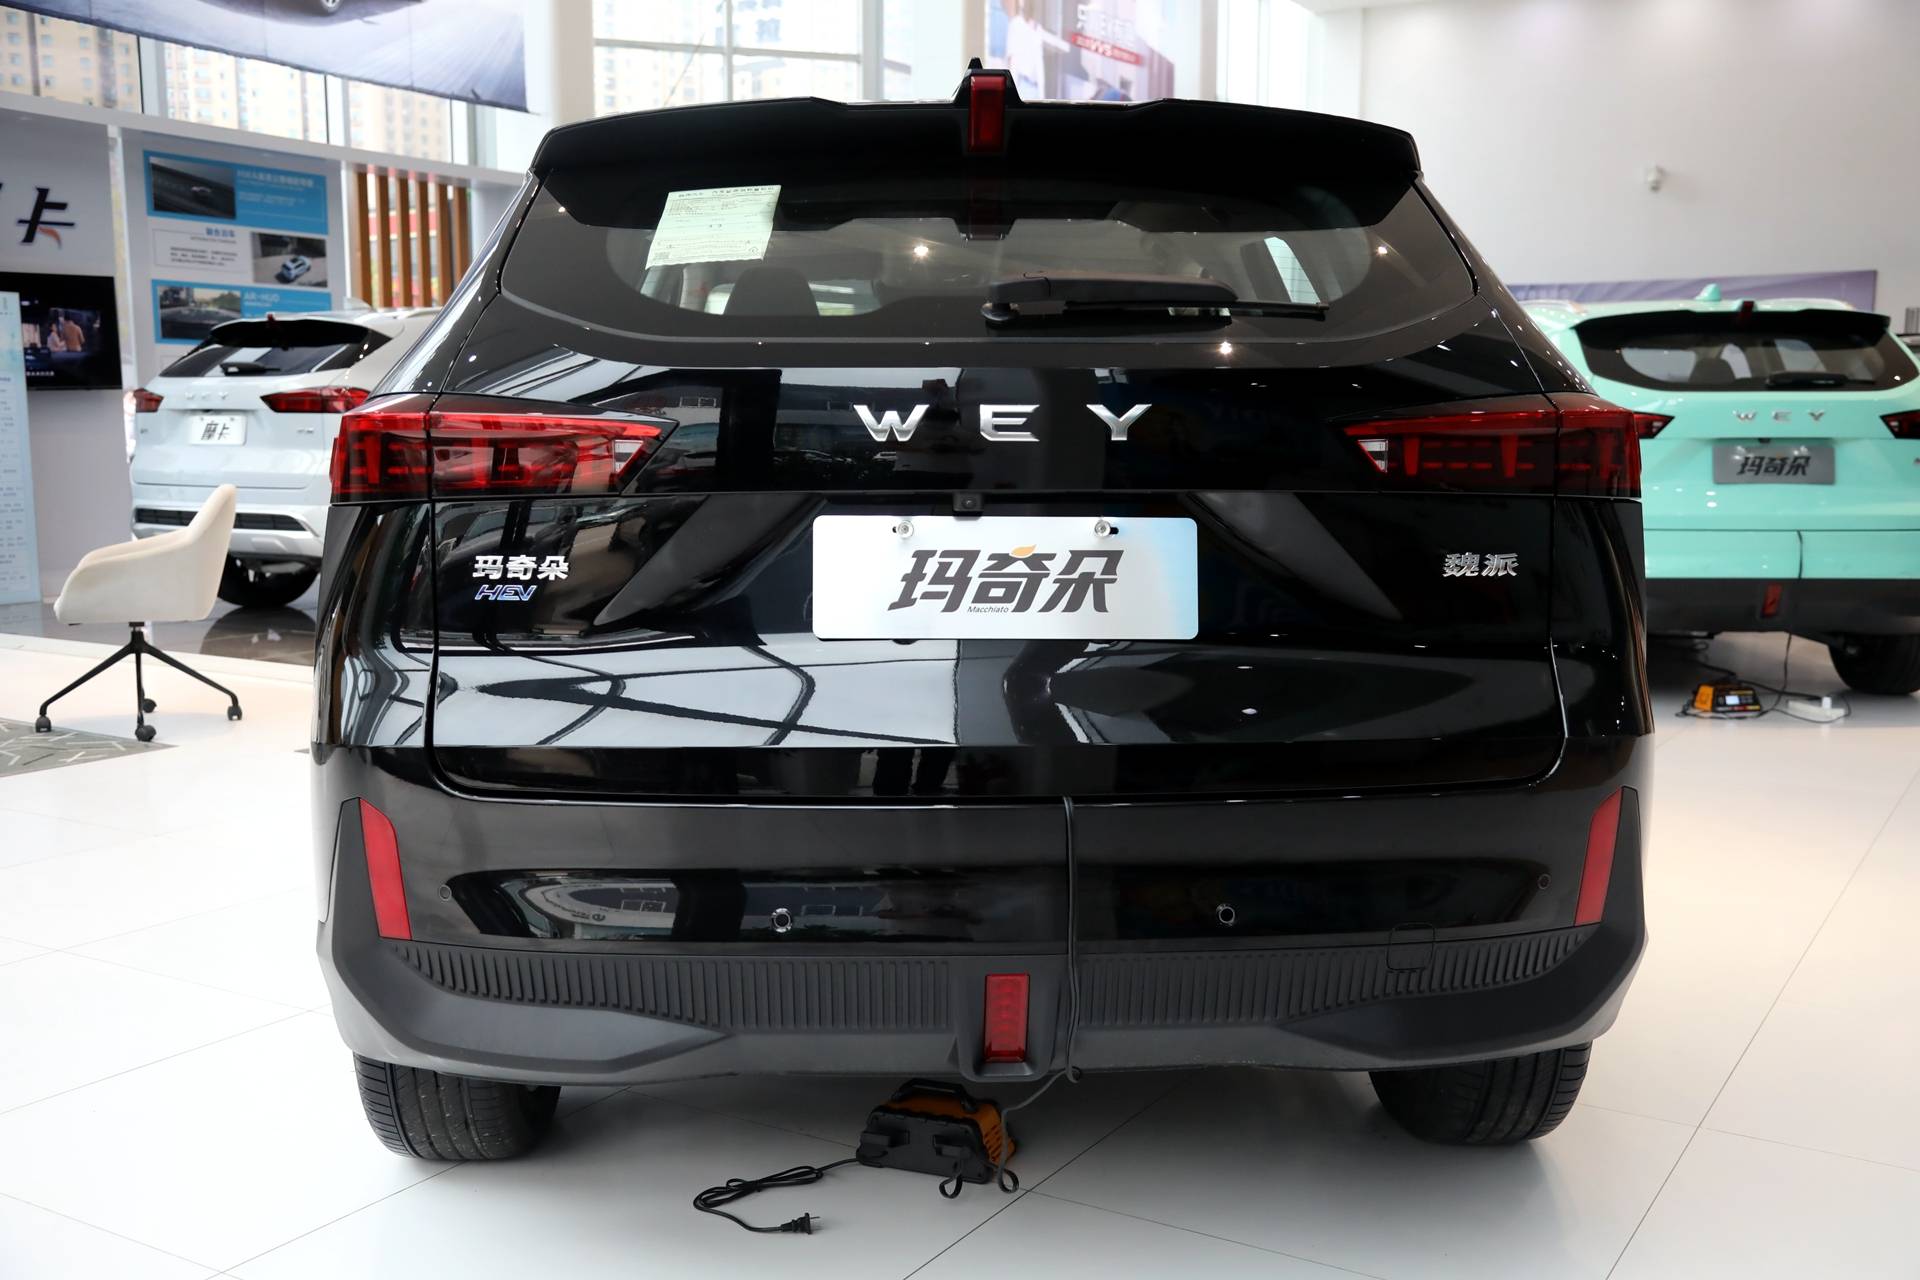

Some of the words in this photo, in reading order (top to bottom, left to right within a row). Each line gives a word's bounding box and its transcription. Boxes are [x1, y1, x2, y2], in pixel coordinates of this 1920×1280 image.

[0, 182, 75, 249] 卡
[853, 404, 1152, 441] WEY
[1733, 410, 1825, 421] WEY
[201, 421, 230, 440] 摩卡
[1737, 455, 1811, 476] 玛奇朵
[472, 555, 569, 580] 玛奇朵
[1442, 552, 1519, 577] 魏派
[888, 545, 1124, 613] 玛奇朵
[475, 584, 538, 601] HEV
